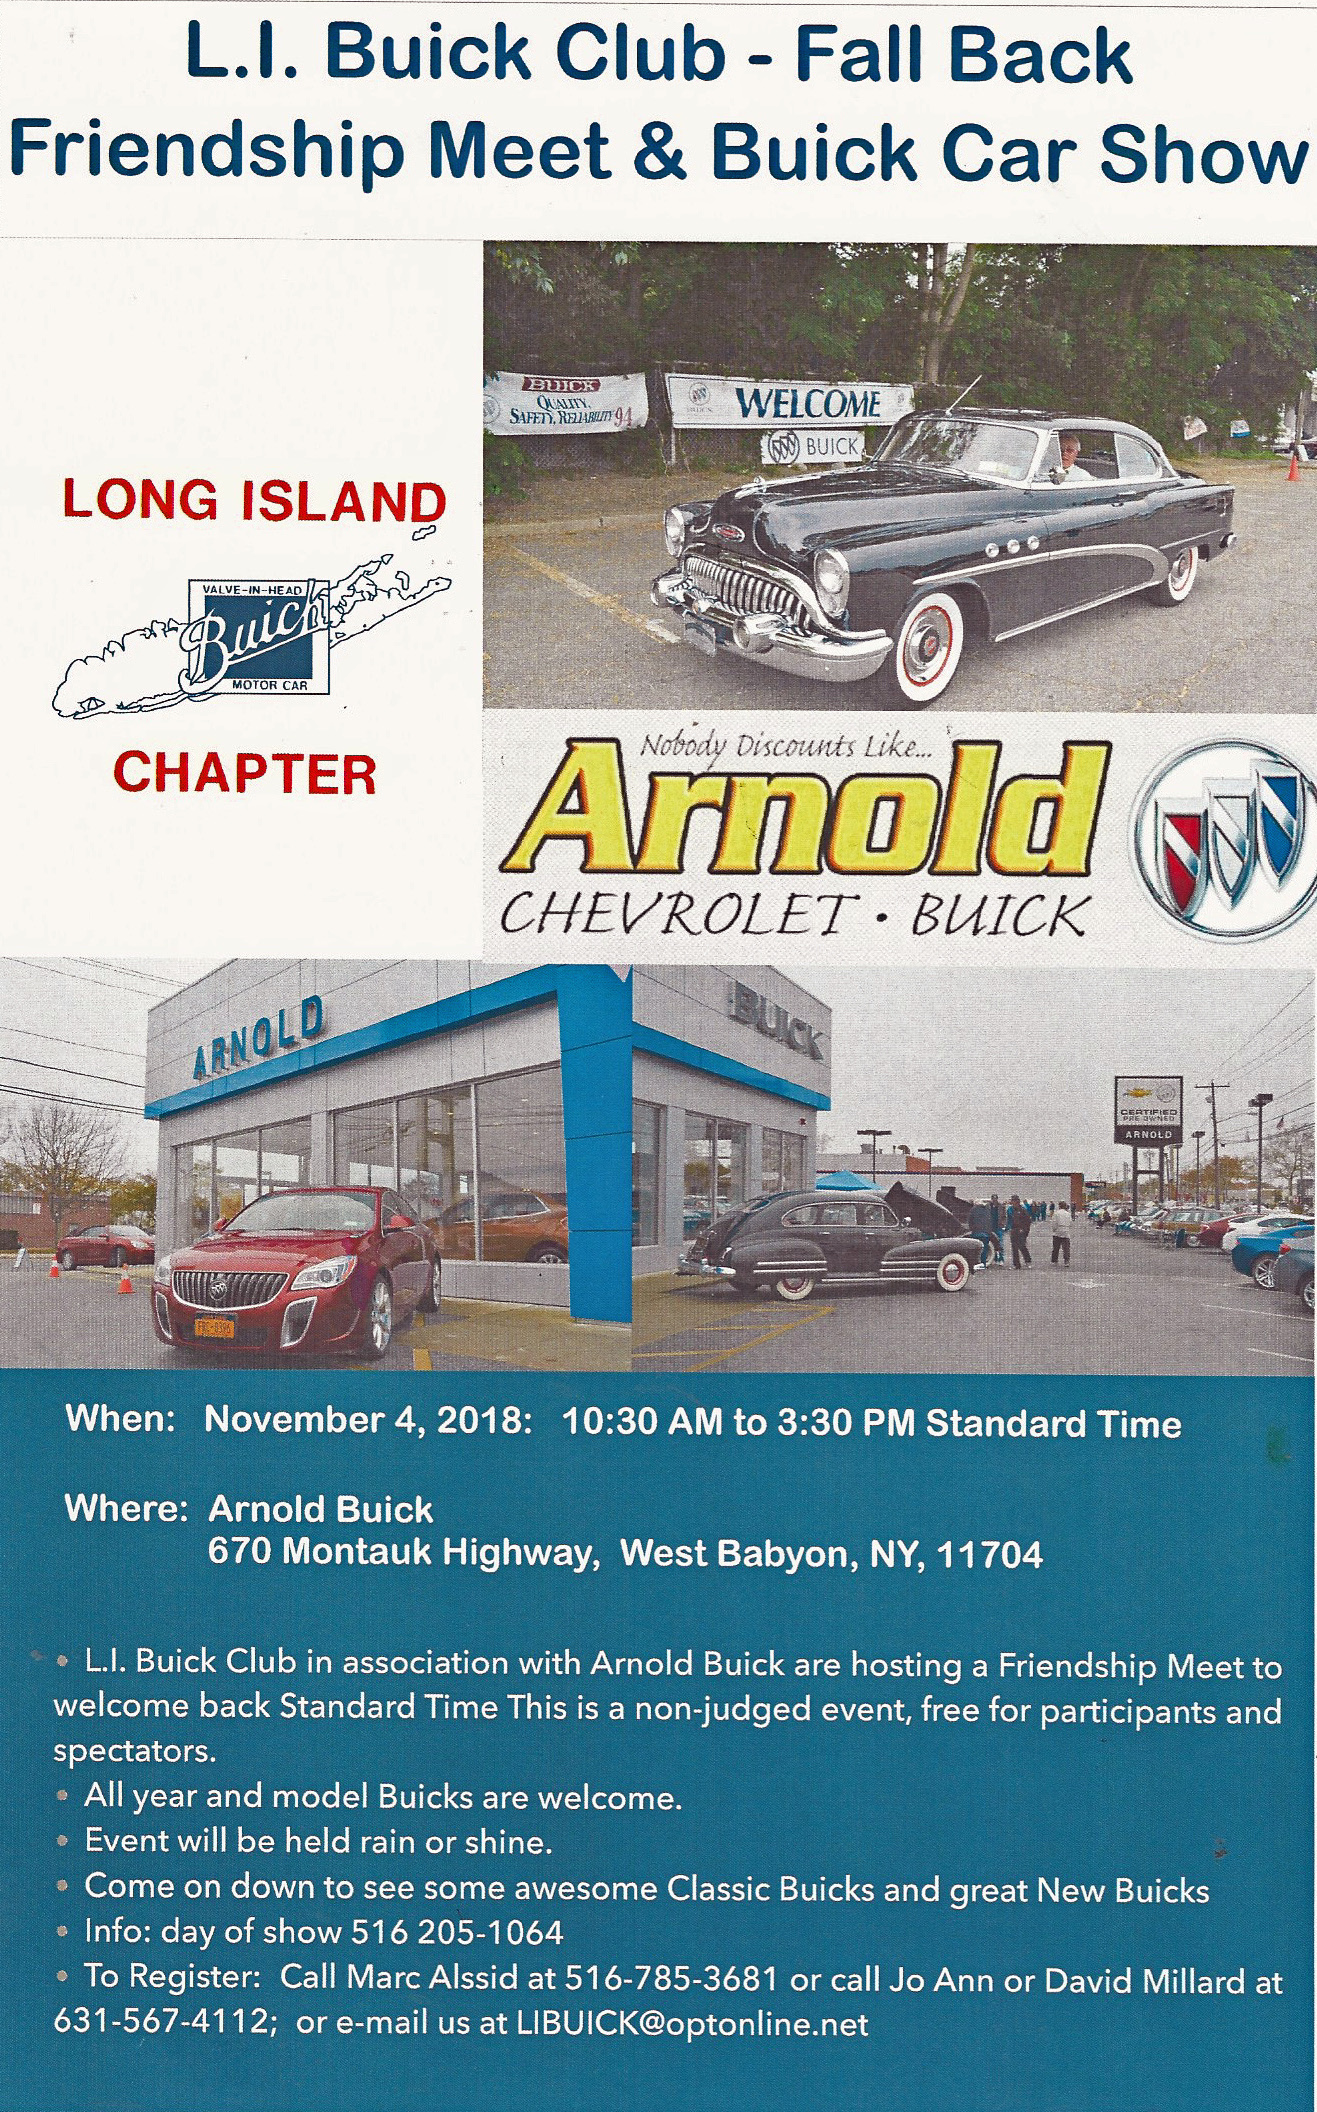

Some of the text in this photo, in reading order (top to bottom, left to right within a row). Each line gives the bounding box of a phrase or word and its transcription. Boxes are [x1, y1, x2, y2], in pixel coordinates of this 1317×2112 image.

[187, 19, 1134, 85] L.I. Buick Club - Fall Back
[11, 117, 1310, 194] Friendship Meet & Buick Car Show
[527, 379, 596, 391] BUICK
[735, 388, 880, 418] WELCOME
[614, 407, 632, 427] 94
[807, 438, 858, 455] BUICK
[63, 477, 447, 523] LONG ISLAND
[203, 585, 302, 595] VALVE-IN-HEAD
[233, 680, 308, 690] MOTOR CAR
[640, 729, 932, 770] Nobody Discounts Like...
[113, 749, 377, 795] CHAPTER
[499, 737, 1112, 877] Arnold
[501, 891, 1092, 937] CHEVROLET BUICK
[193, 995, 323, 1080] ARNOLD
[729, 981, 824, 1060] BUICK
[1125, 1130, 1172, 1139] ARNOLD
[65, 1403, 1182, 1439] When: November 4, 2018: 10:30 AM to 3:30 PM Standard Time
[64, 1493, 434, 1524] Where: Arnold Buick
[208, 1535, 1044, 1575] 670 Montauk Highway, West Babyon, NY, 11704
[86, 1646, 1283, 1686] L.I. Buick Club in association with Arnold Buick are hosting a Friendship Meet to
[53, 1690, 1282, 1732] welcome back Standard Time This is a non-judged event, free for participants and
[53, 1740, 216, 1770] spectators.
[83, 1779, 682, 1815] All year and model Buicks are welcome.
[86, 1825, 552, 1855] Event will be held rain or shine.
[85, 1870, 1210, 1910] Come on down to see some awesome Classic Buicks and great New Buicks
[86, 1915, 564, 1951] Info: day of show 516 205-1064
[83, 1961, 1284, 1996] To Register: Call Marc Alssid at 516-785-3681 or call Jo Ann or David Millard at
[54, 2006, 869, 2044] 631-567-4112; or e-mail us at LIBUICK@optonline.net
